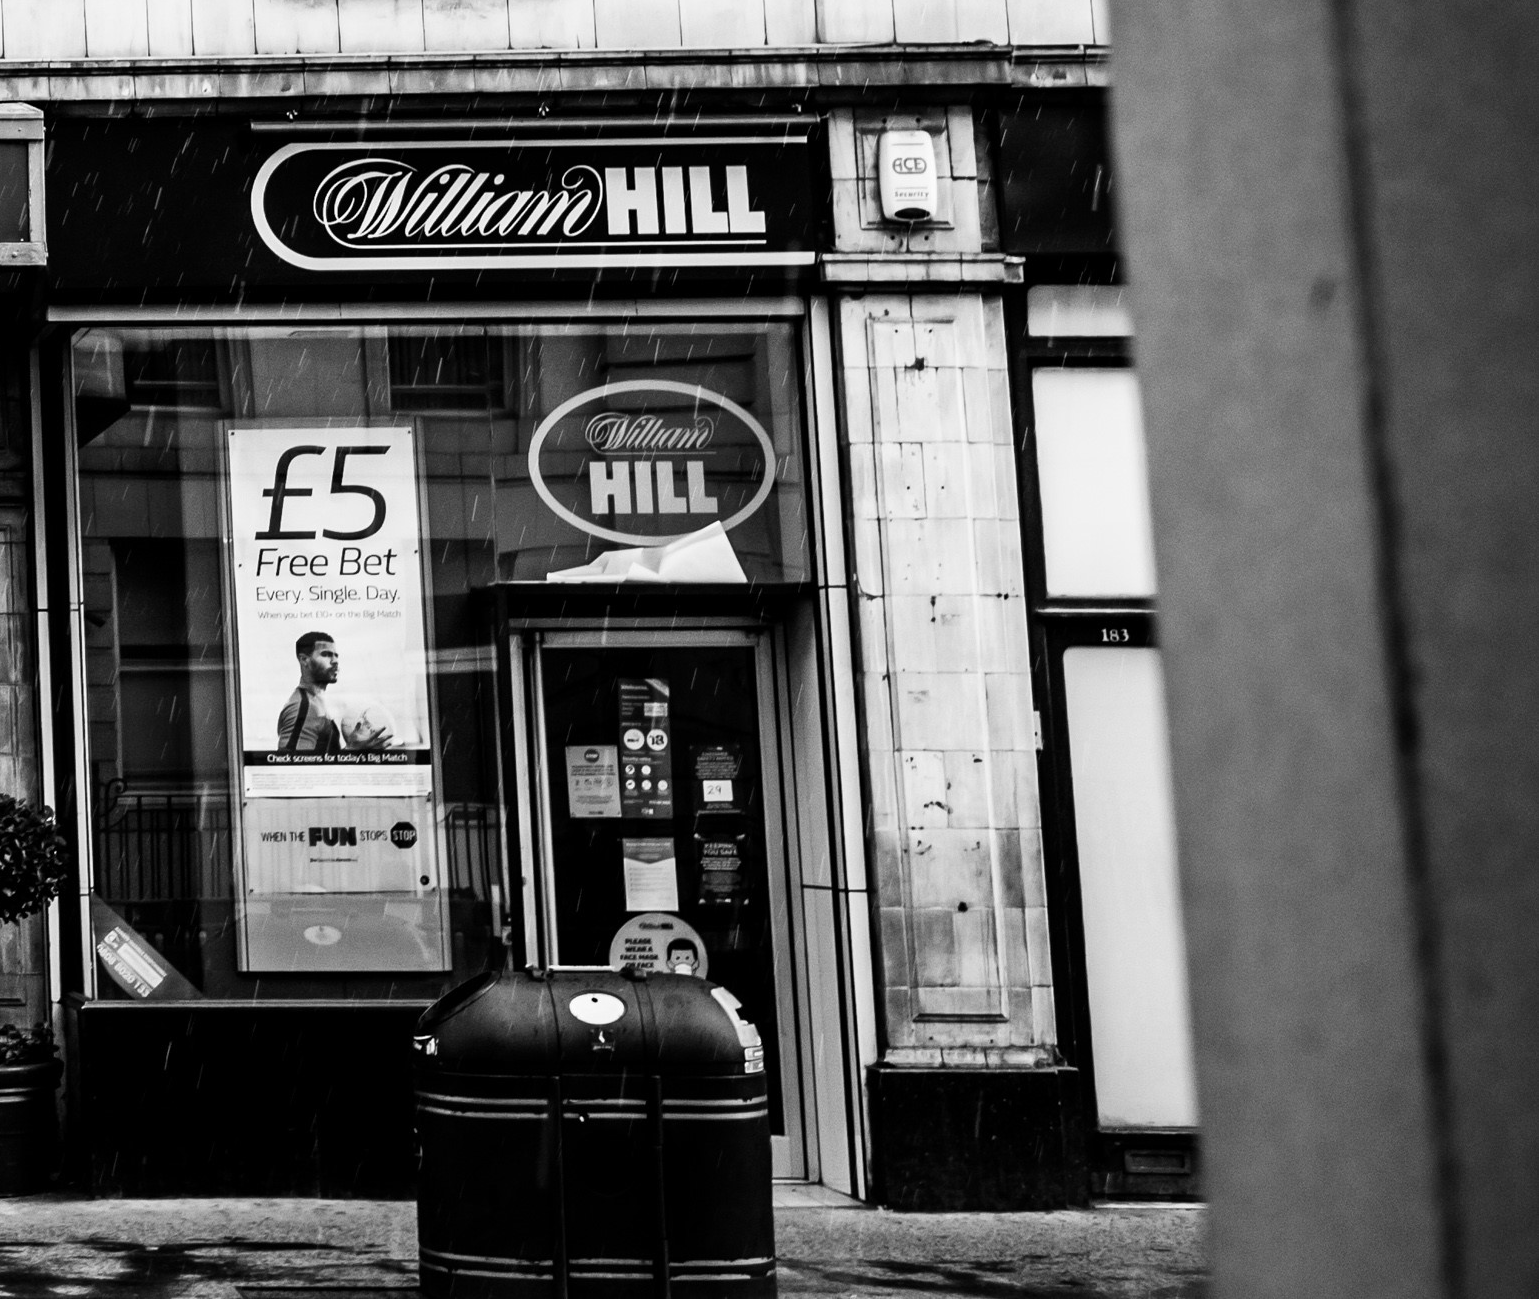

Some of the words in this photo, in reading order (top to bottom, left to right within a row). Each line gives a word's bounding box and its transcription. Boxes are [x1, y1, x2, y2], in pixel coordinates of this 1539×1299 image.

[892, 157, 927, 175] ACE
[312, 157, 603, 242] William
[604, 164, 766, 236] HILL
[585, 412, 715, 451] William
[254, 444, 391, 541] £5
[589, 460, 718, 515] HILL
[256, 547, 329, 577] Free
[339, 547, 398, 577] Bet
[256, 586, 304, 604] Every.
[309, 585, 361, 605] Single.
[366, 585, 401, 604] Day.
[1102, 627, 1129, 642] 183
[266, 753, 292, 763] Check
[293, 754, 323, 763] screens
[324, 753, 335, 762] for
[337, 753, 366, 764] today's
[367, 753, 380, 764] Big
[381, 753, 408, 762] Match
[260, 831, 287, 843] WHEN
[289, 831, 306, 842] THE
[308, 826, 357, 847] FUN
[359, 830, 388, 842] STOPS
[392, 829, 416, 842] STOP
